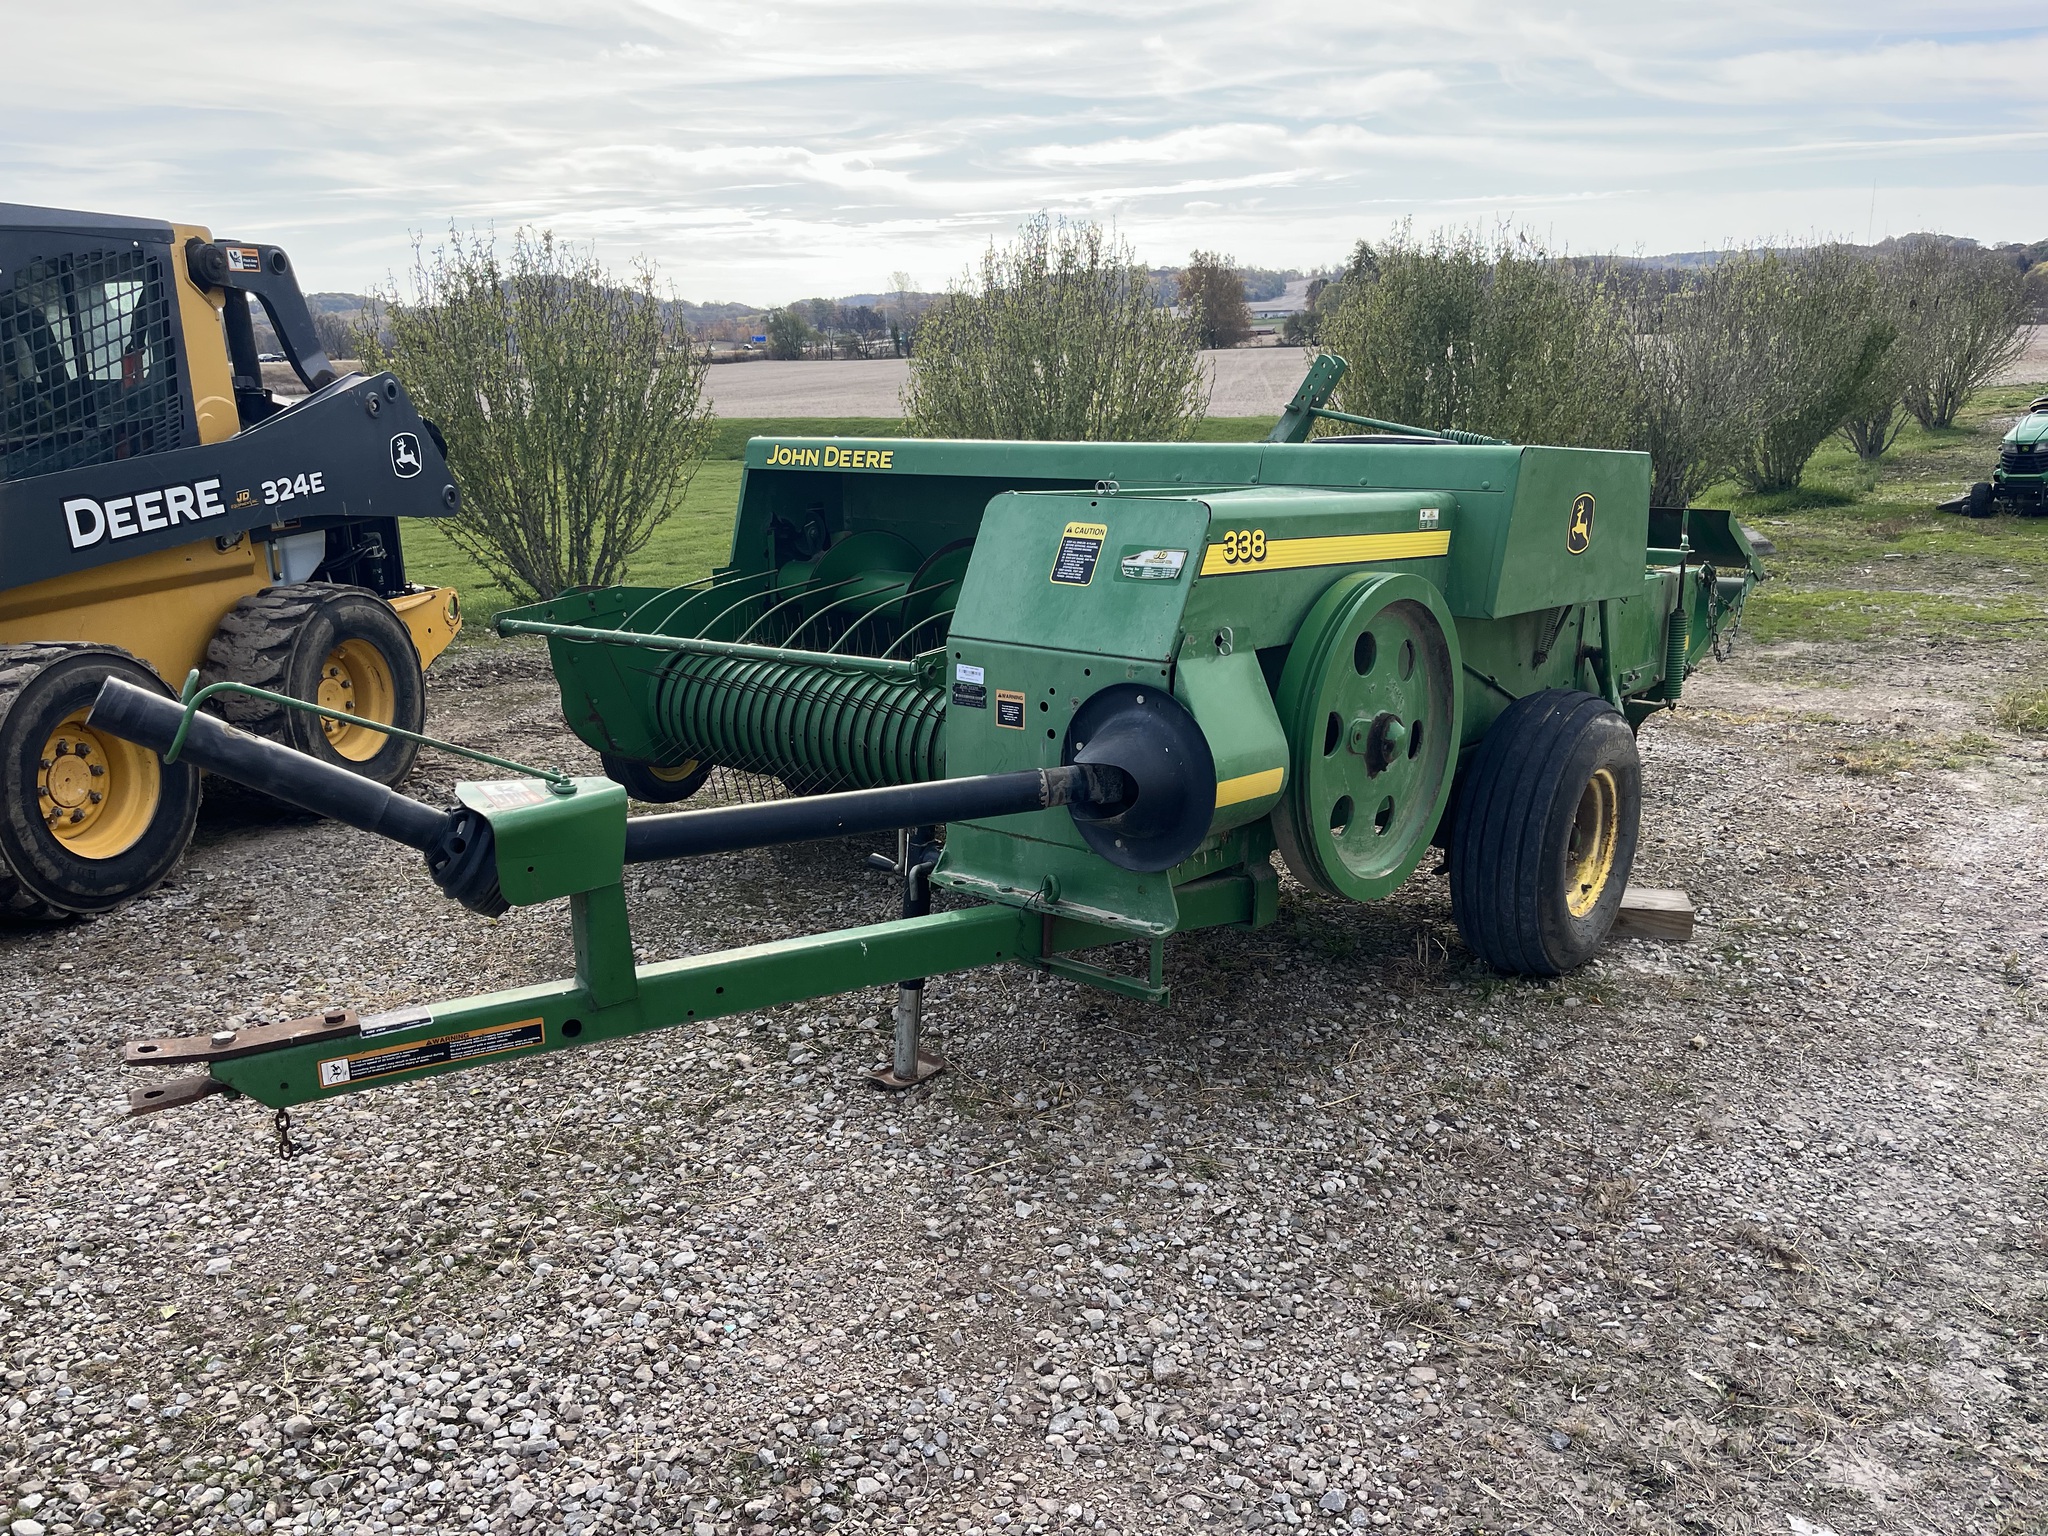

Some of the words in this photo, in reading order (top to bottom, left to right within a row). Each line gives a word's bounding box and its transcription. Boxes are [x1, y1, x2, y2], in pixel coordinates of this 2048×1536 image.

[766, 444, 820, 466] JOHN
[823, 446, 894, 469] DEERE
[261, 471, 325, 505] 324E
[236, 491, 250, 503] JD
[64, 478, 226, 549] DEERE
[1074, 526, 1106, 536] CAUTION
[1222, 528, 1267, 564] 338
[1153, 550, 1168, 560] JD
[1002, 693, 1023, 701] WARNING
[432, 1032, 470, 1045] WARNING
